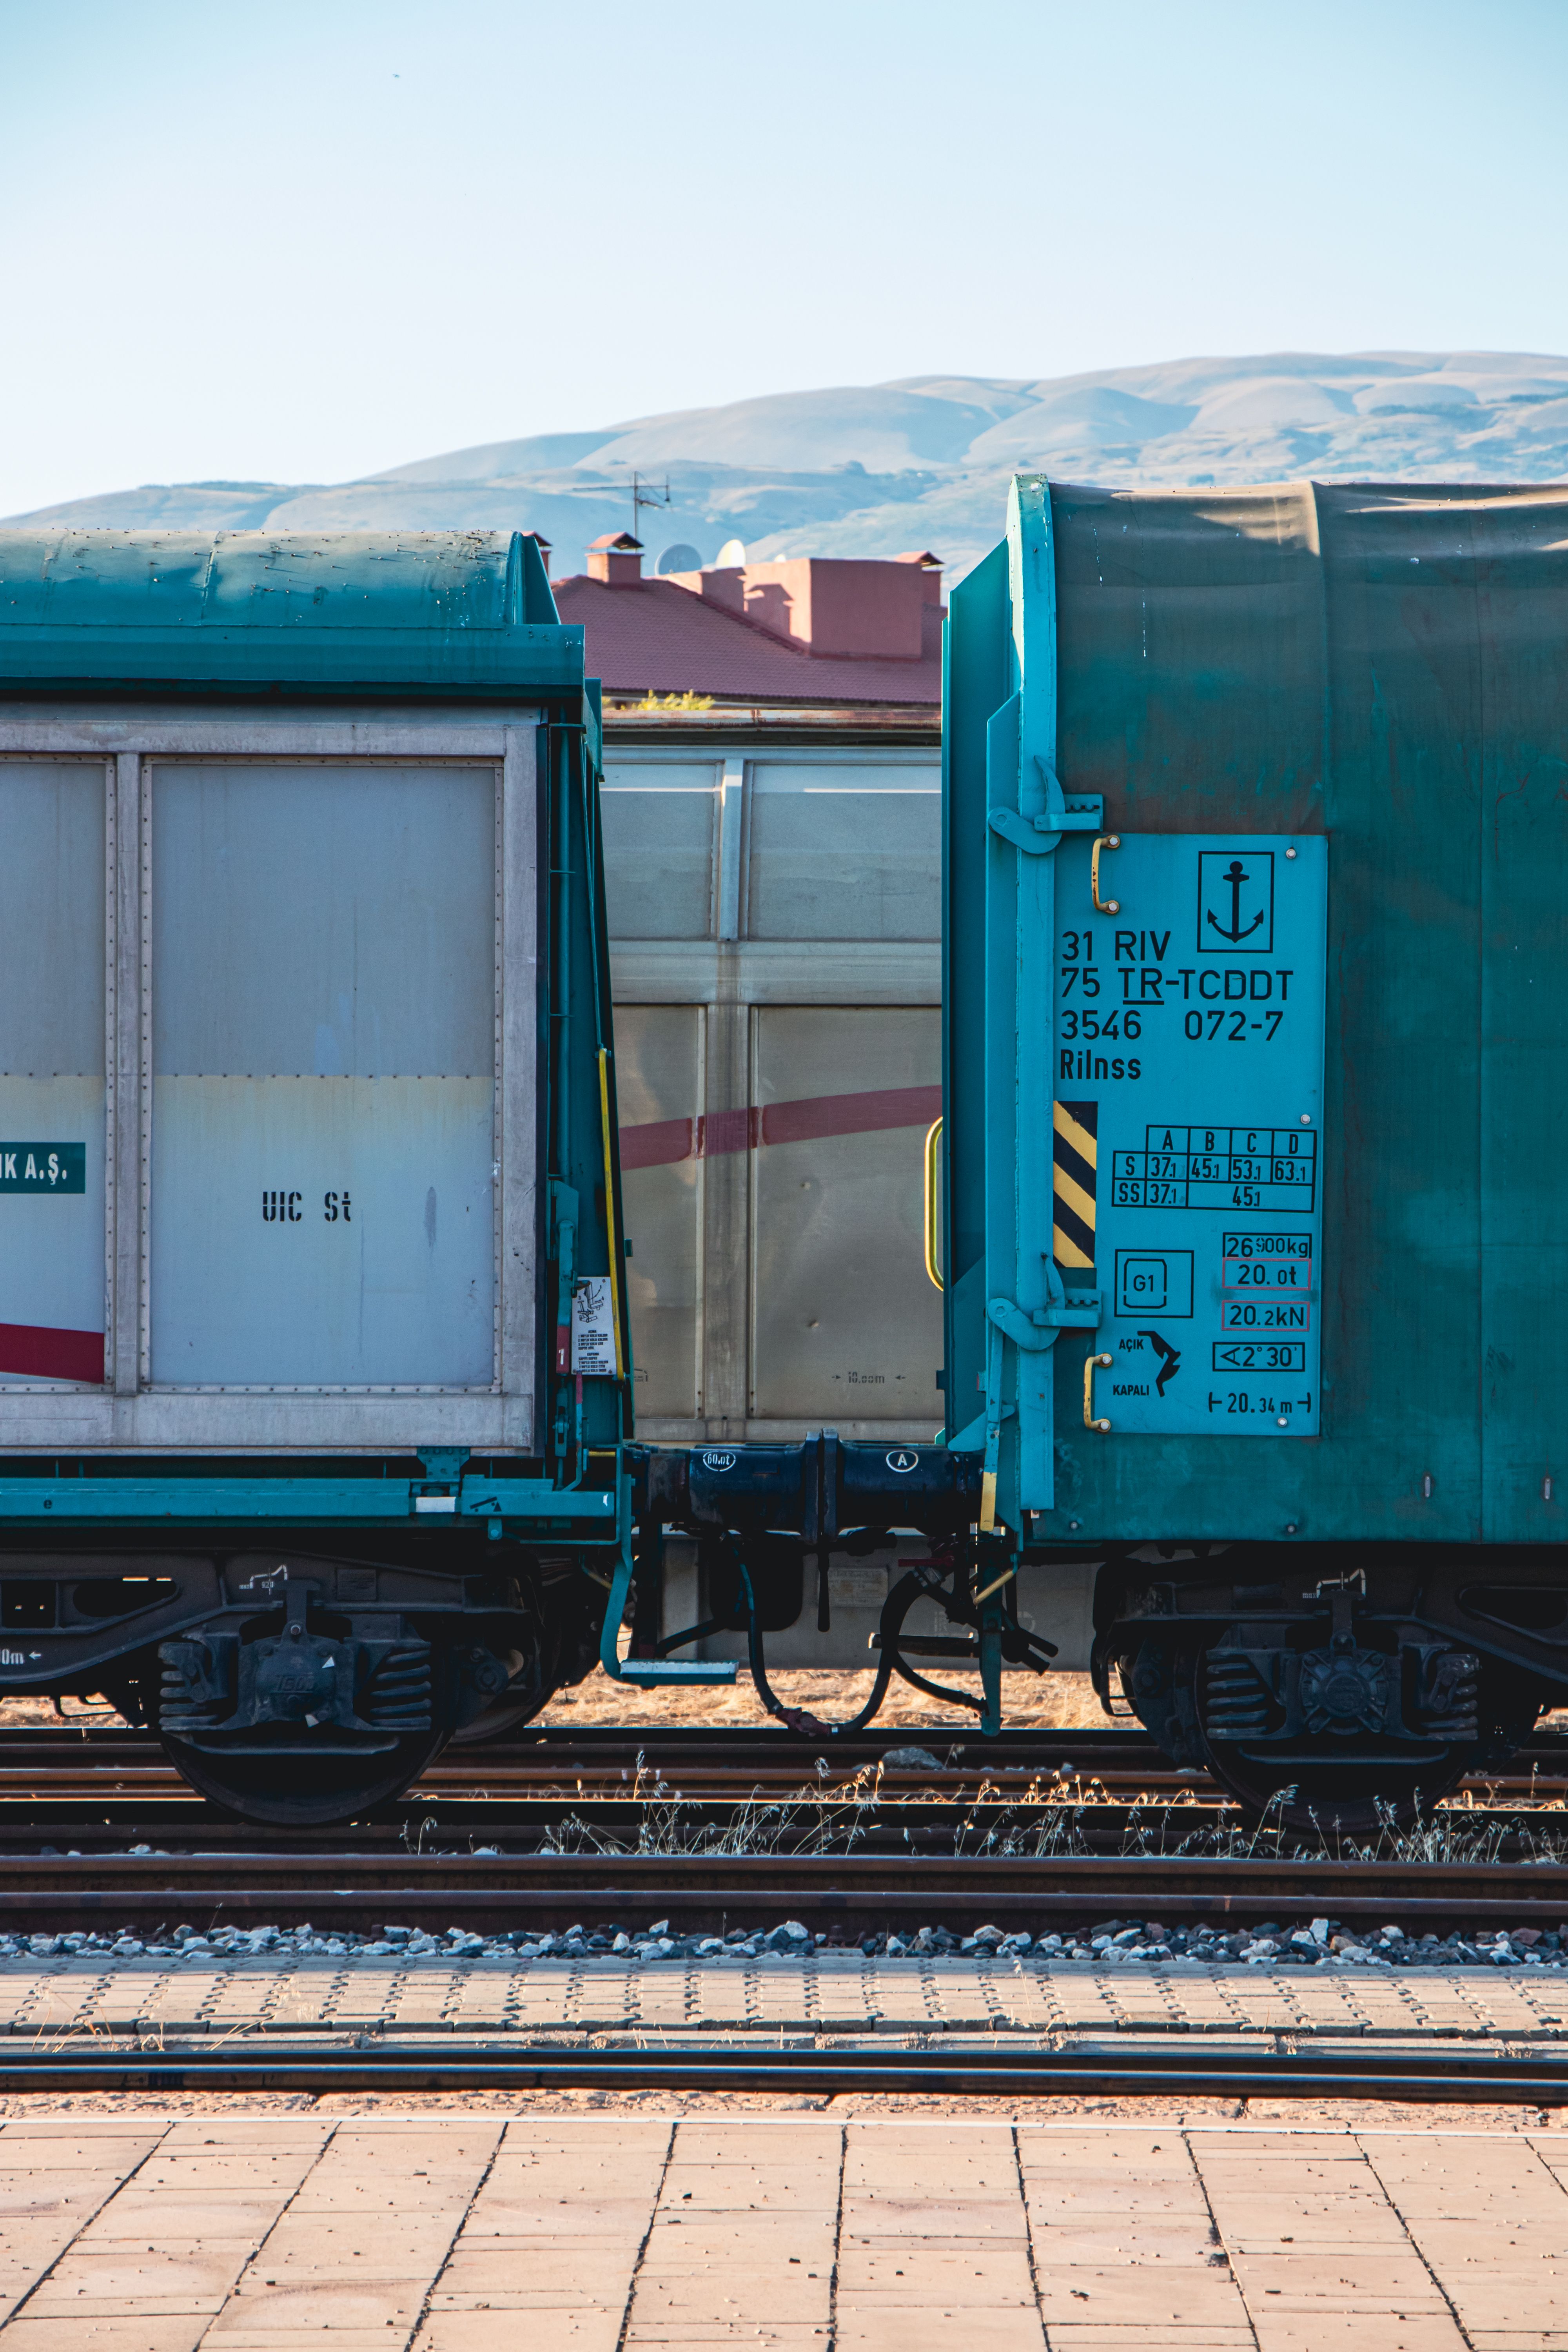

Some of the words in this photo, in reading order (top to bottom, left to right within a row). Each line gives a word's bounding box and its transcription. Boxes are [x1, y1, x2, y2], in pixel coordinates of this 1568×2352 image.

[1062, 931, 1093, 961] 31
[1115, 931, 1171, 961] RIV
[1061, 967, 1100, 998] 75
[1118, 968, 1294, 1003] TR-TCDDT
[1061, 1010, 1141, 1040] 3546
[1185, 1010, 1283, 1041] 072-7
[1060, 1049, 1141, 1080] Rilnss
[1162, 1130, 1173, 1150] A
[1205, 1131, 1214, 1152] B
[1247, 1133, 1257, 1152] C
[1289, 1134, 1299, 1154] D
[24, 1153, 67, 1185] A.Ş.
[1126, 1156, 1135, 1176] S
[1275, 1160, 1305, 1182] 63.1
[1119, 1183, 1140, 1203] SS
[262, 1192, 301, 1221] UIC
[325, 1192, 351, 1221] St
[1134, 1275, 1154, 1292] G1
[559, 1349, 564, 1365] 1
[1119, 1339, 1144, 1352] AÇIK
[1113, 1385, 1149, 1396] KAPALI
[1281, 1402, 1292, 1413] m
[897, 1454, 907, 1466] A
